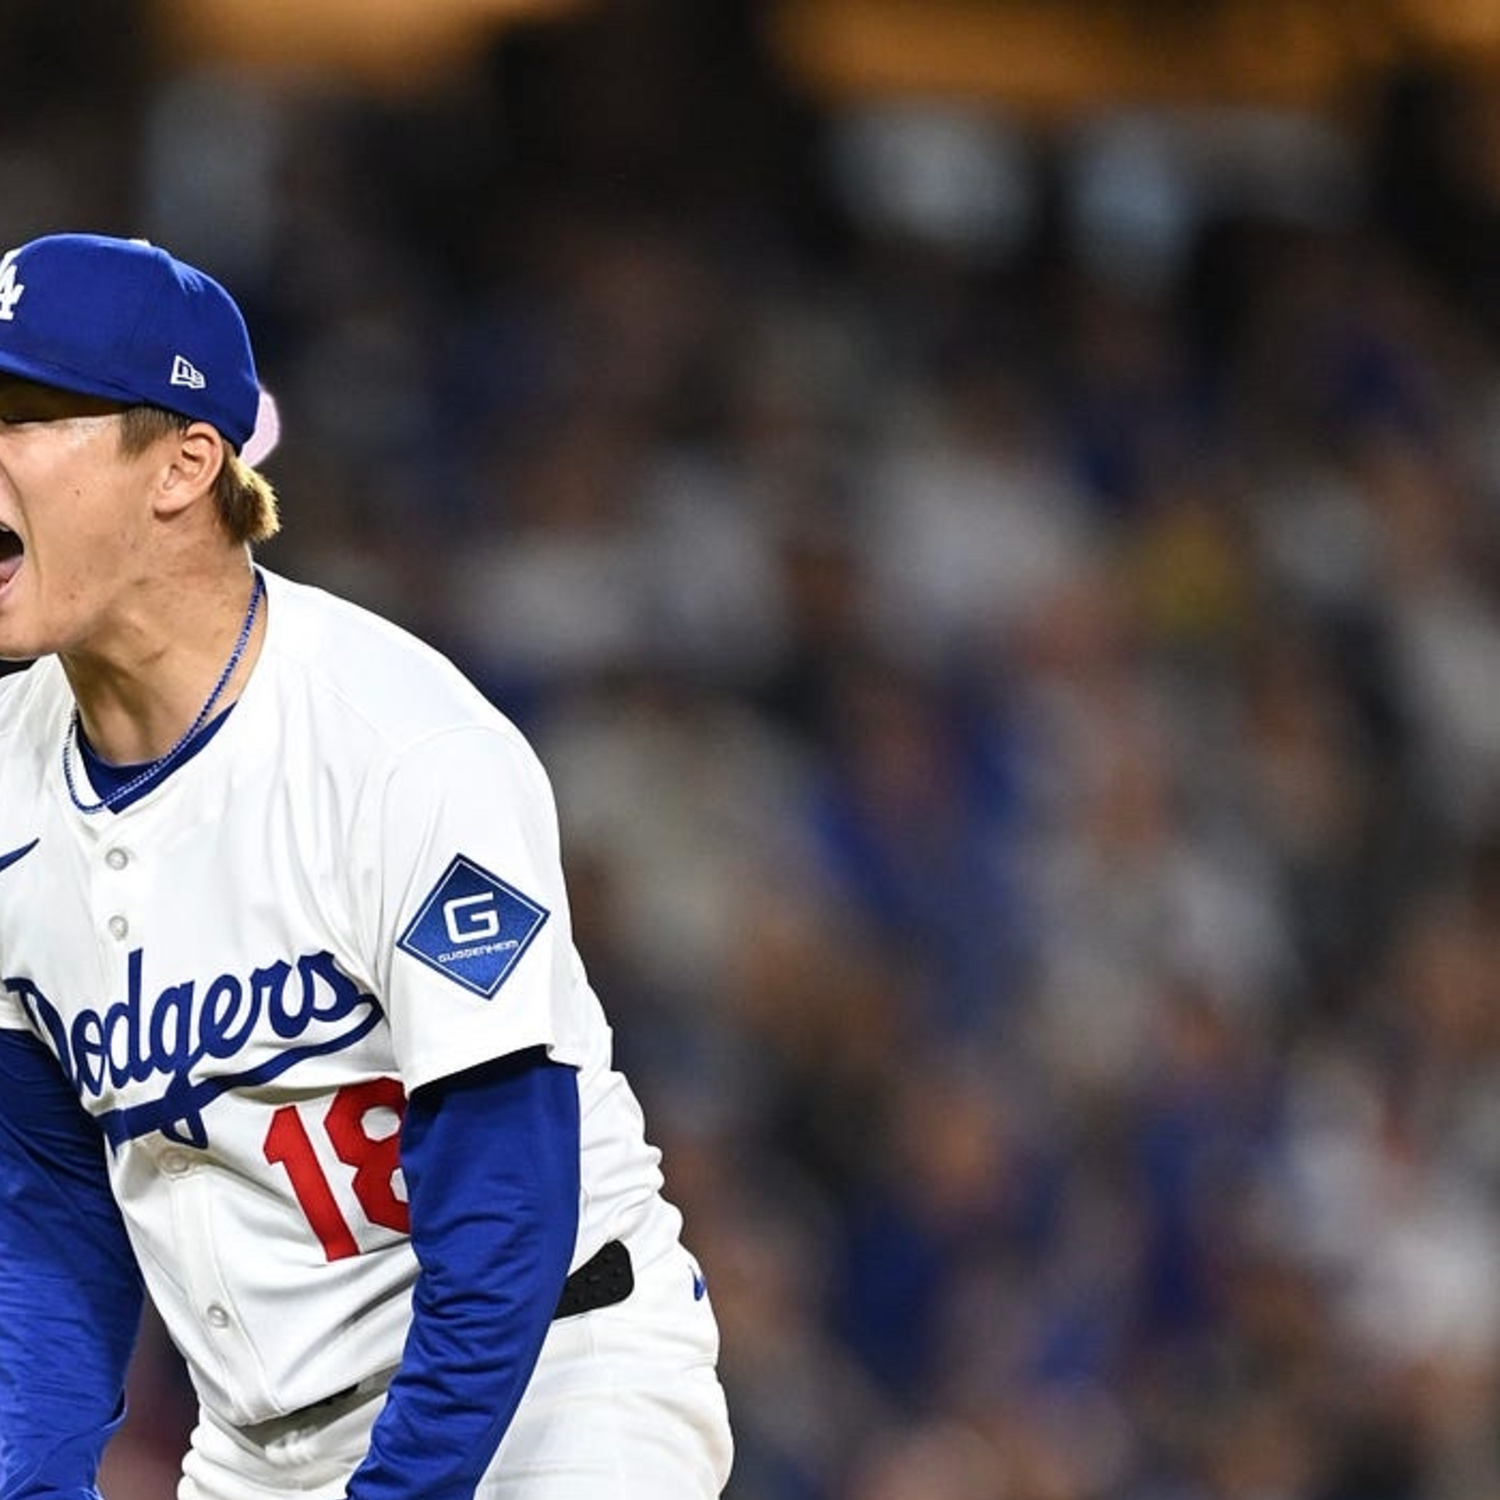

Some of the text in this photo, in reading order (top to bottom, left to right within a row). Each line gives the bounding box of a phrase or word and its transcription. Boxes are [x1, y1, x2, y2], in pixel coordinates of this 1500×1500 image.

[442, 890, 500, 944] G
[3, 947, 384, 1155] Dodgers
[262, 1075, 411, 1263] 18
